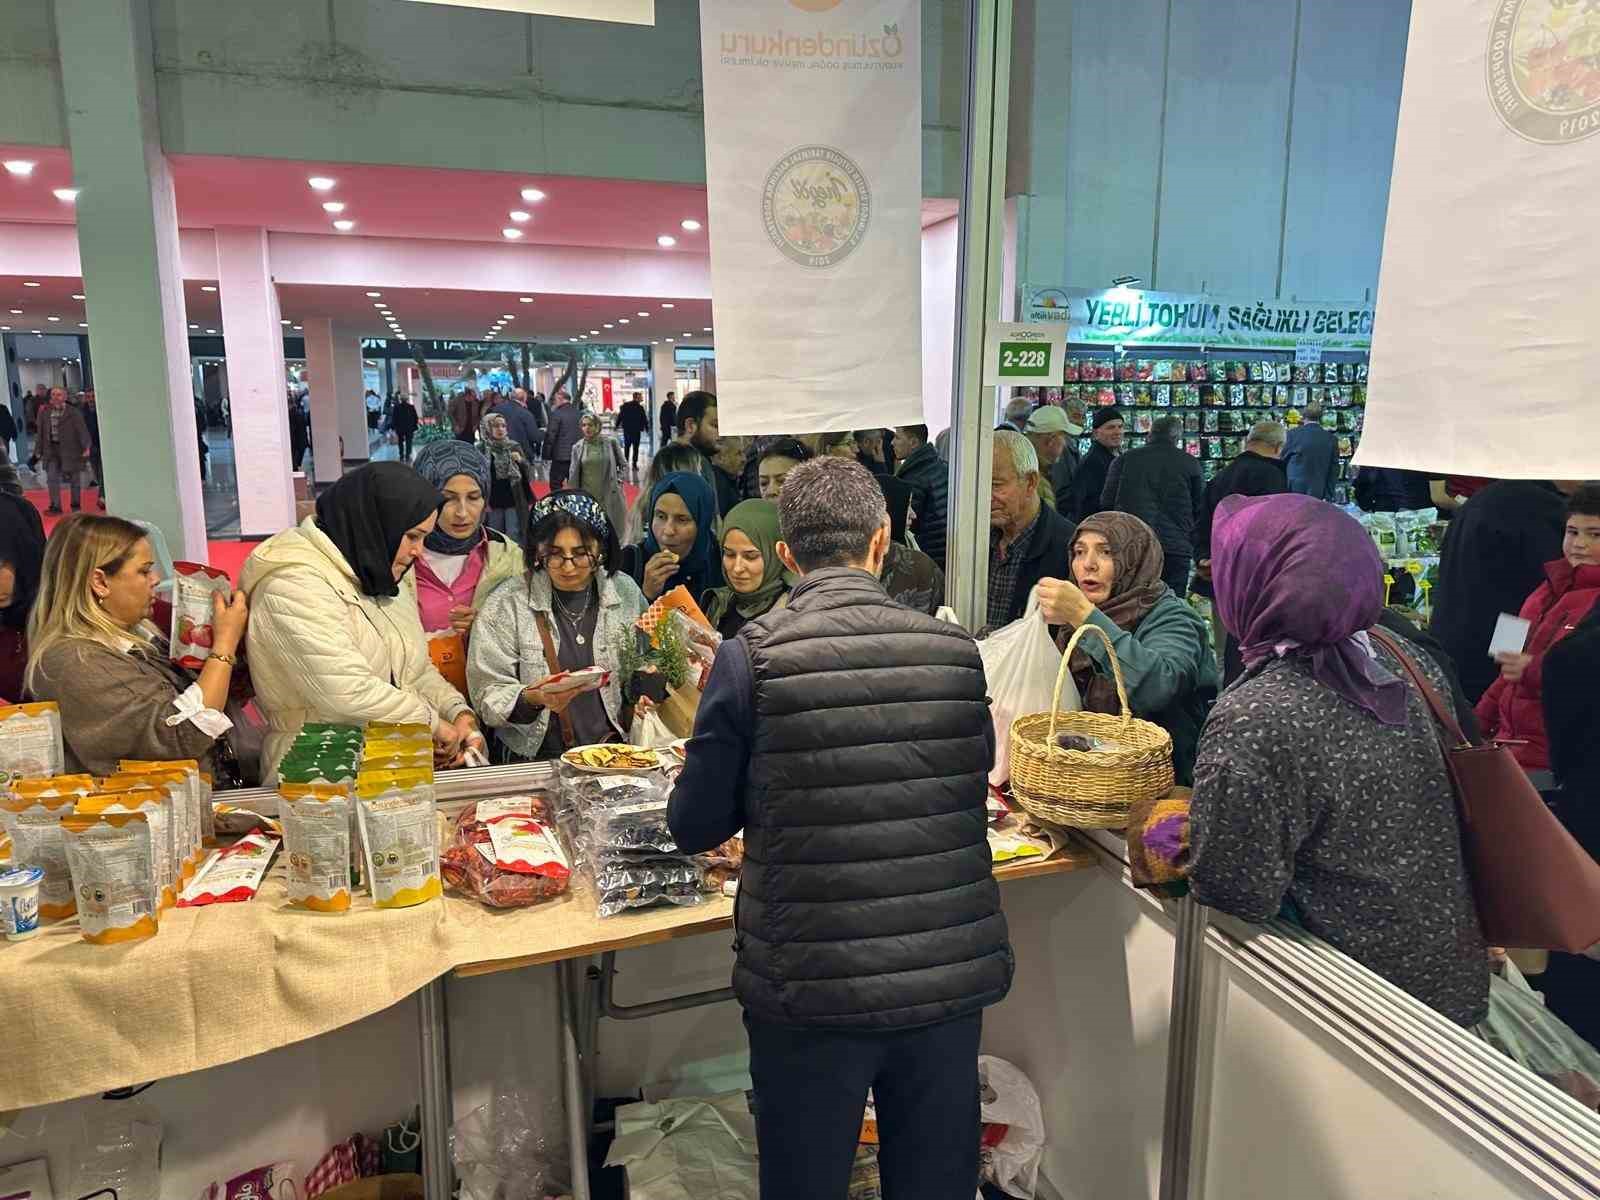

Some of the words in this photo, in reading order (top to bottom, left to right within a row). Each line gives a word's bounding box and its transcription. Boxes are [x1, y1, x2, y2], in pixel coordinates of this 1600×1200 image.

[1085, 294, 1144, 327] YERLİ
[1148, 303, 1224, 334] TOHUM,
[1228, 301, 1310, 333] SAĞLIKLI
[1003, 350, 1046, 367] 2-228
